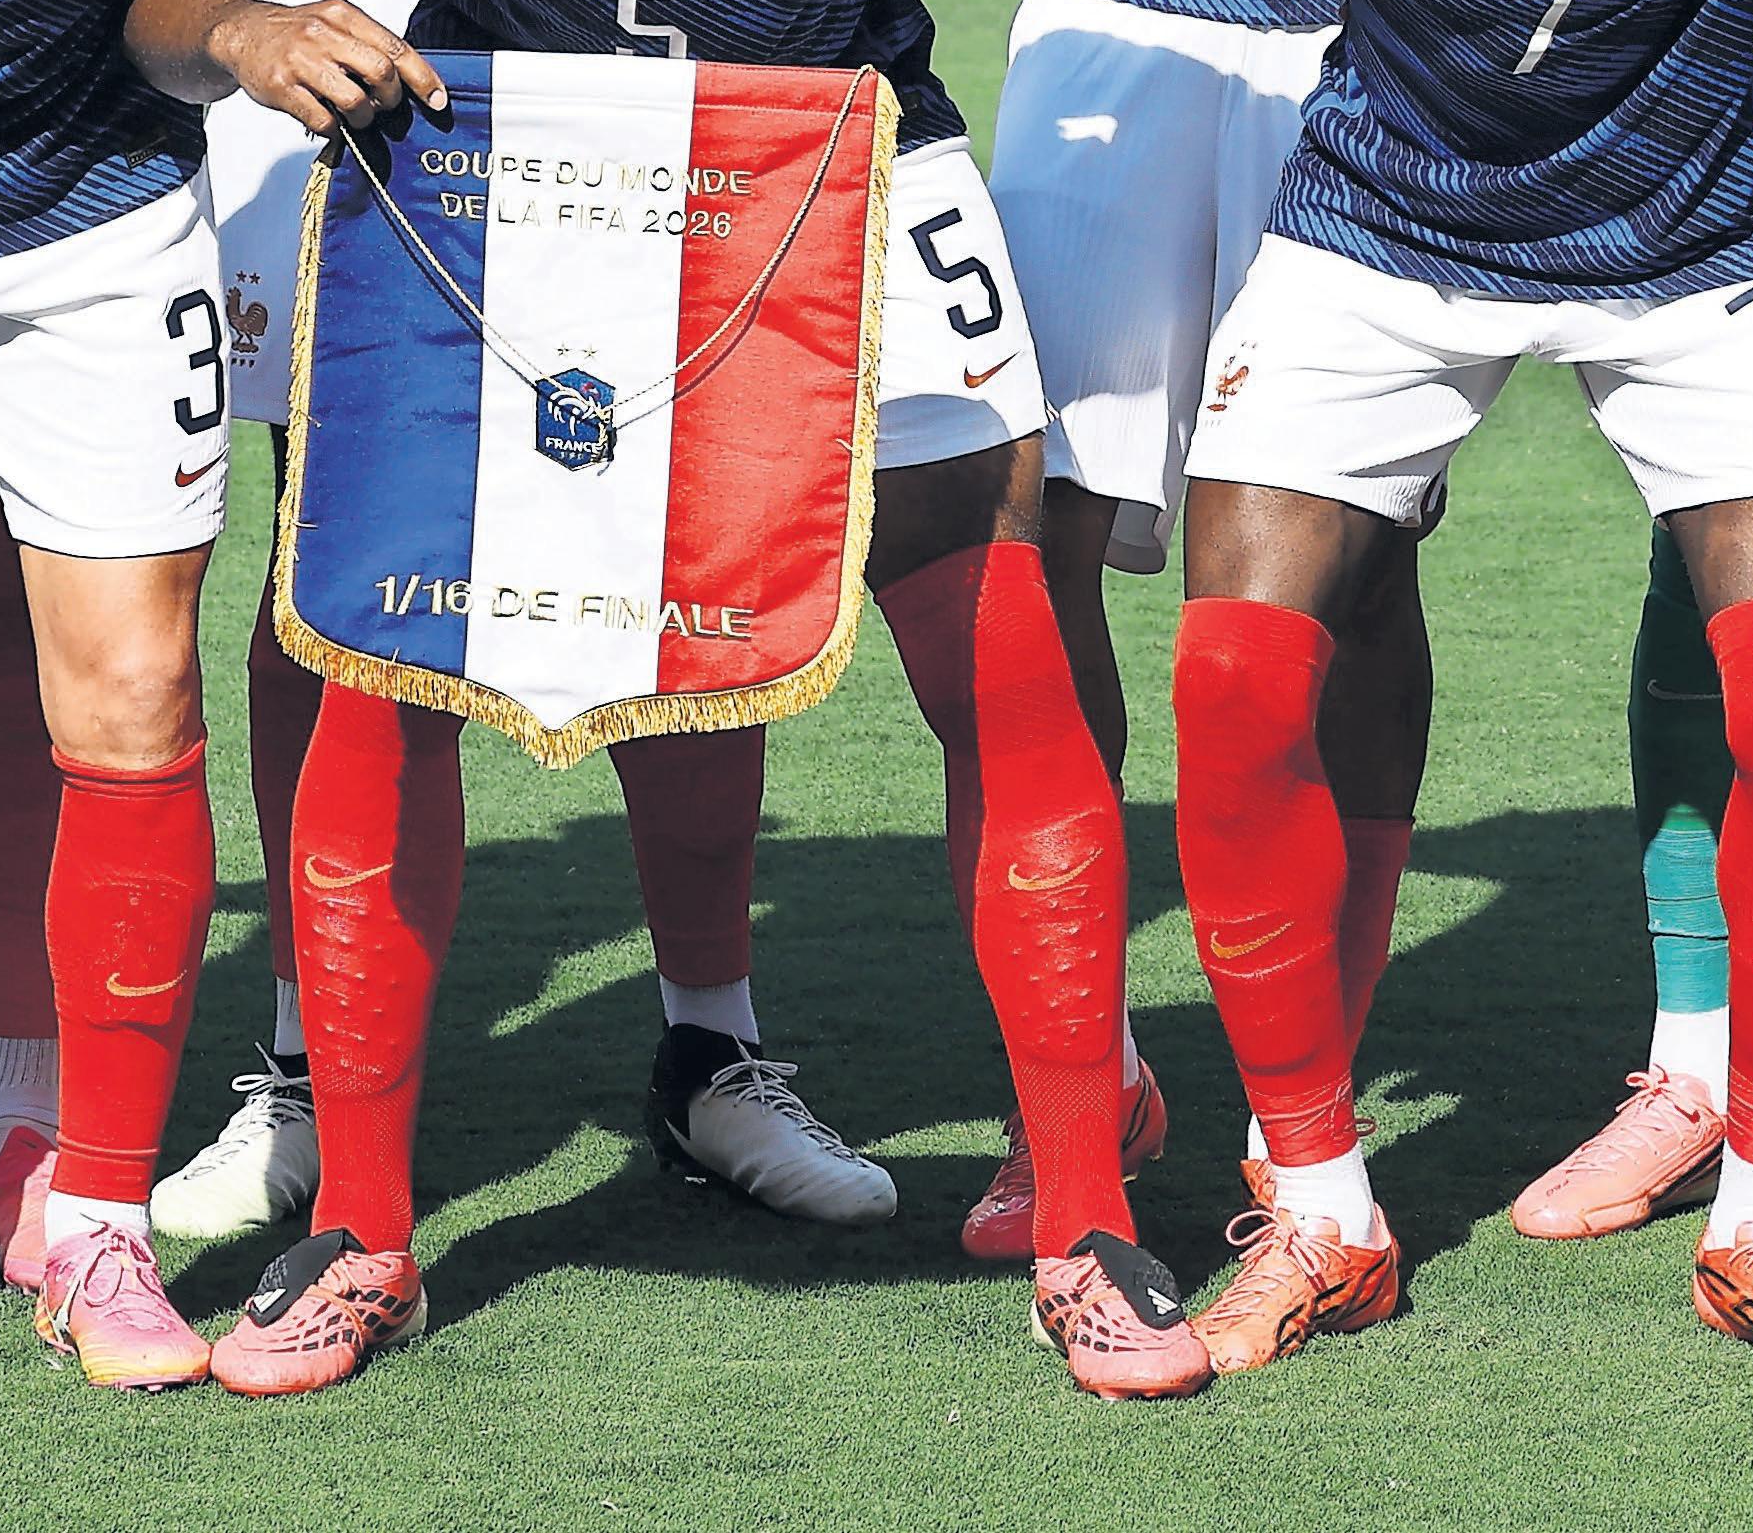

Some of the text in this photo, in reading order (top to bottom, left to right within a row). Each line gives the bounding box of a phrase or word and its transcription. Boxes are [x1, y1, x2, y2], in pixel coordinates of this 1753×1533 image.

[420, 149, 754, 196] COUPE DU MONDE
[440, 192, 734, 238] DE LA FIFA 2026
[908, 208, 1002, 340] 5
[165, 287, 225, 436] 3
[545, 436, 604, 454] FRANCE
[375, 573, 756, 639] 1/16 DE FINALE
